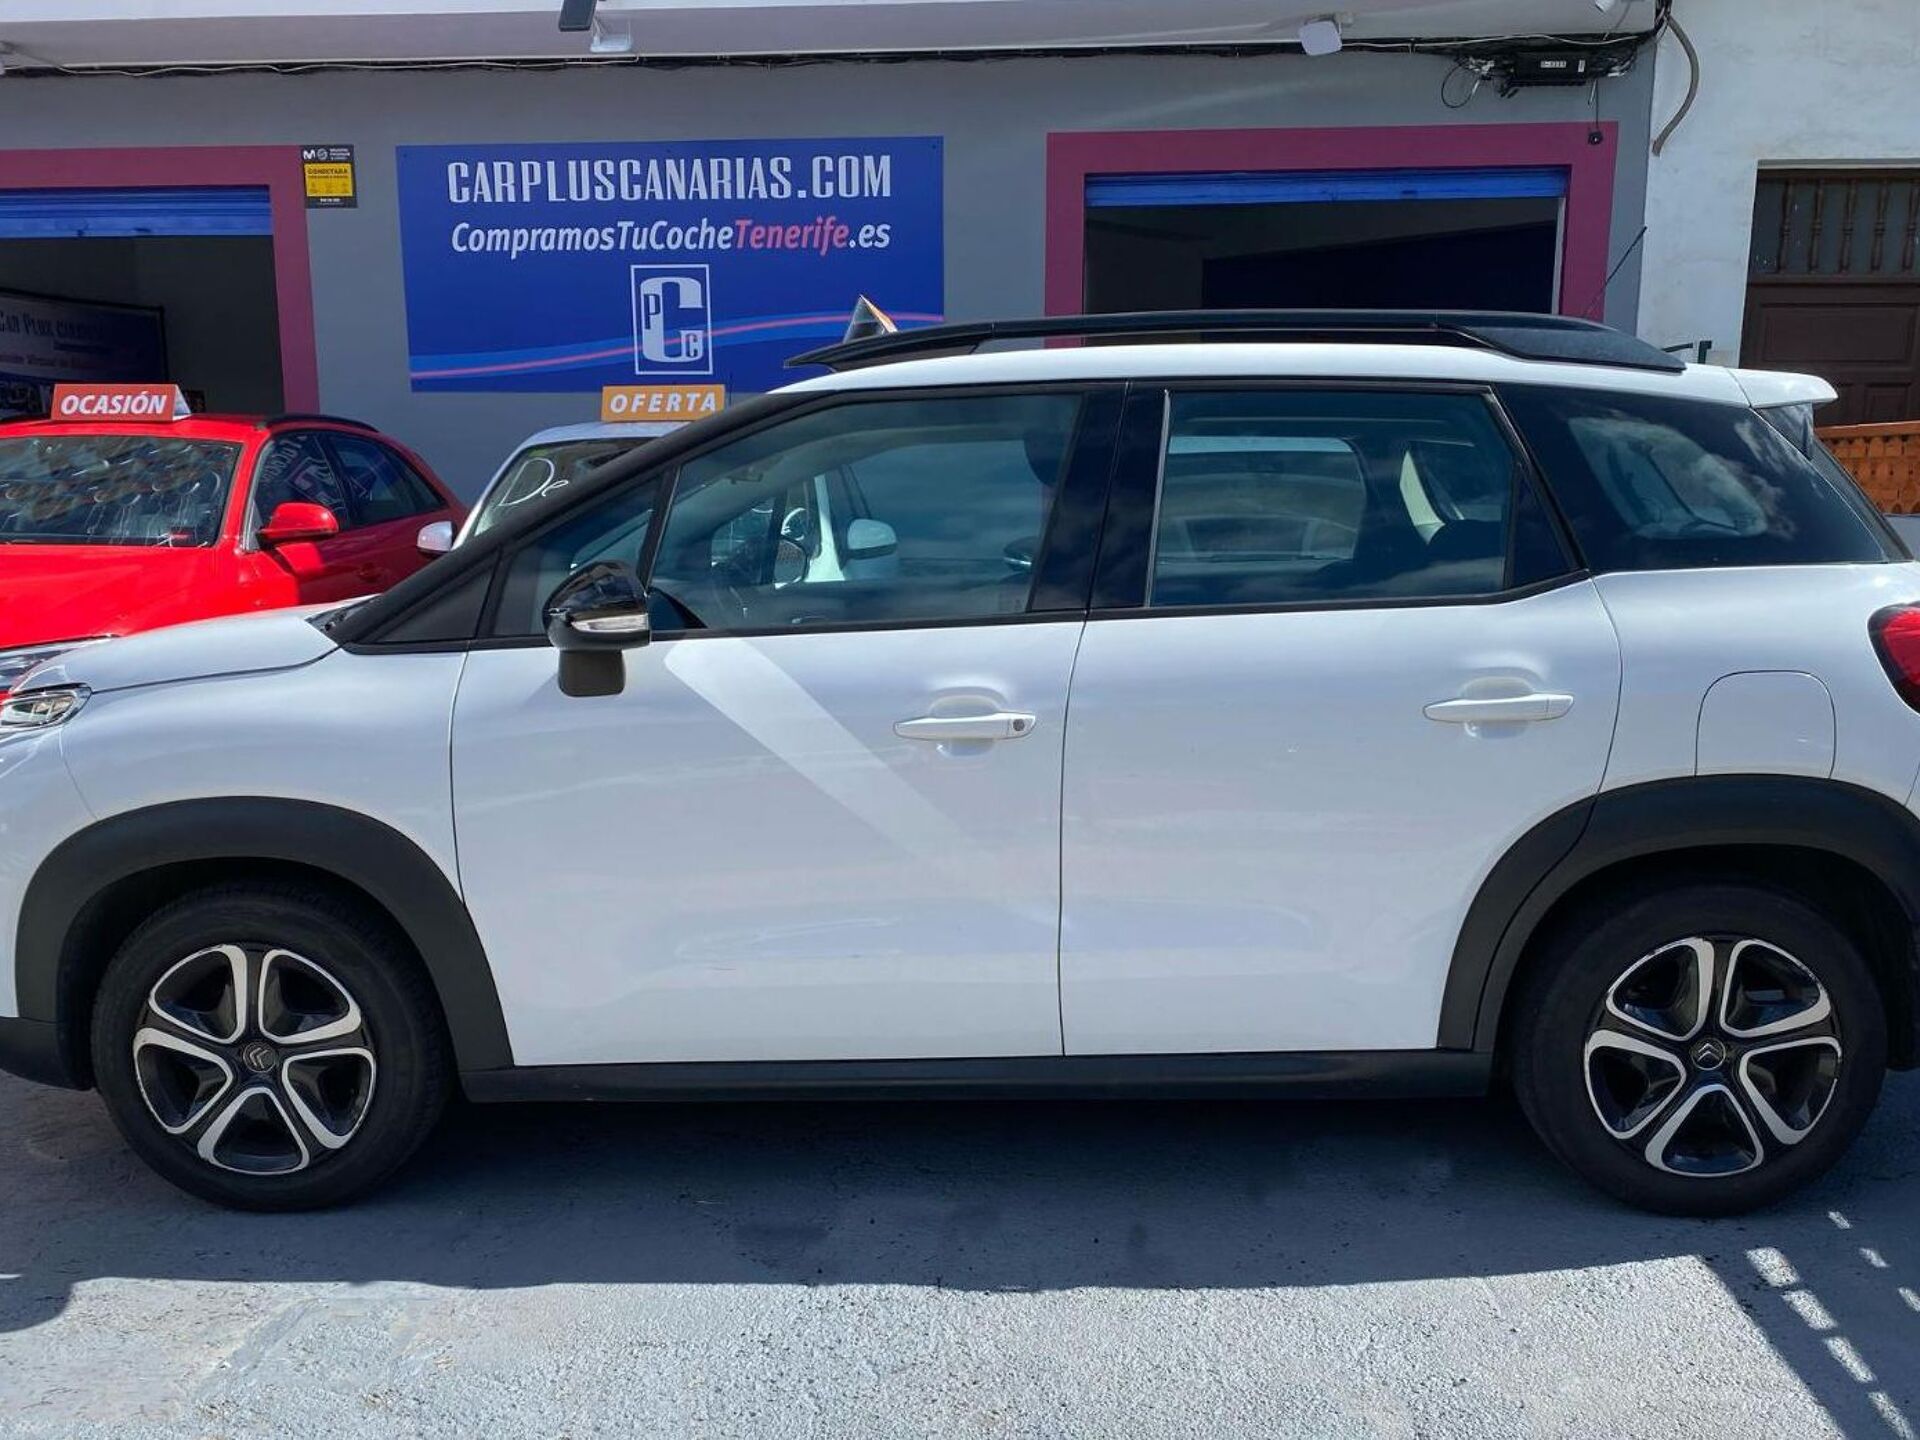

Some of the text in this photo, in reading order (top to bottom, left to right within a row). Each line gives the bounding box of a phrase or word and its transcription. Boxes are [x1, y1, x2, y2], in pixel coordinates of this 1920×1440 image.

[448, 154, 891, 204] CARPLUSCANARIAS.COM
[451, 215, 891, 260] CompramosTuCocheTenerife.es
[60, 390, 168, 415] OCASIÓN
[610, 392, 716, 414] OFERTA
